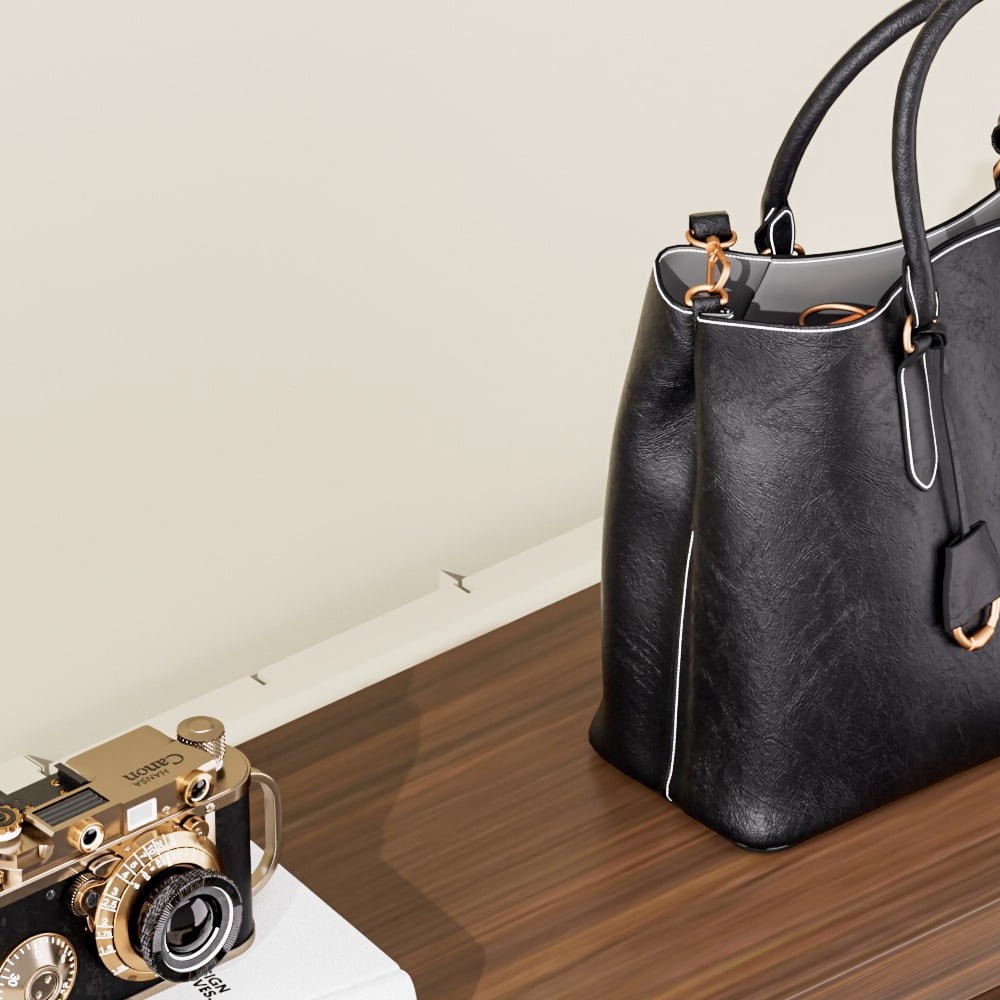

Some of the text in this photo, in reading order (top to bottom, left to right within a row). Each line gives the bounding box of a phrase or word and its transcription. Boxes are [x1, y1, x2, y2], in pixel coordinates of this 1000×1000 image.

[122, 753, 184, 780] Canon
[133, 769, 170, 787] HANSA
[7, 973, 20, 987] 30
[204, 970, 231, 993] IGN
